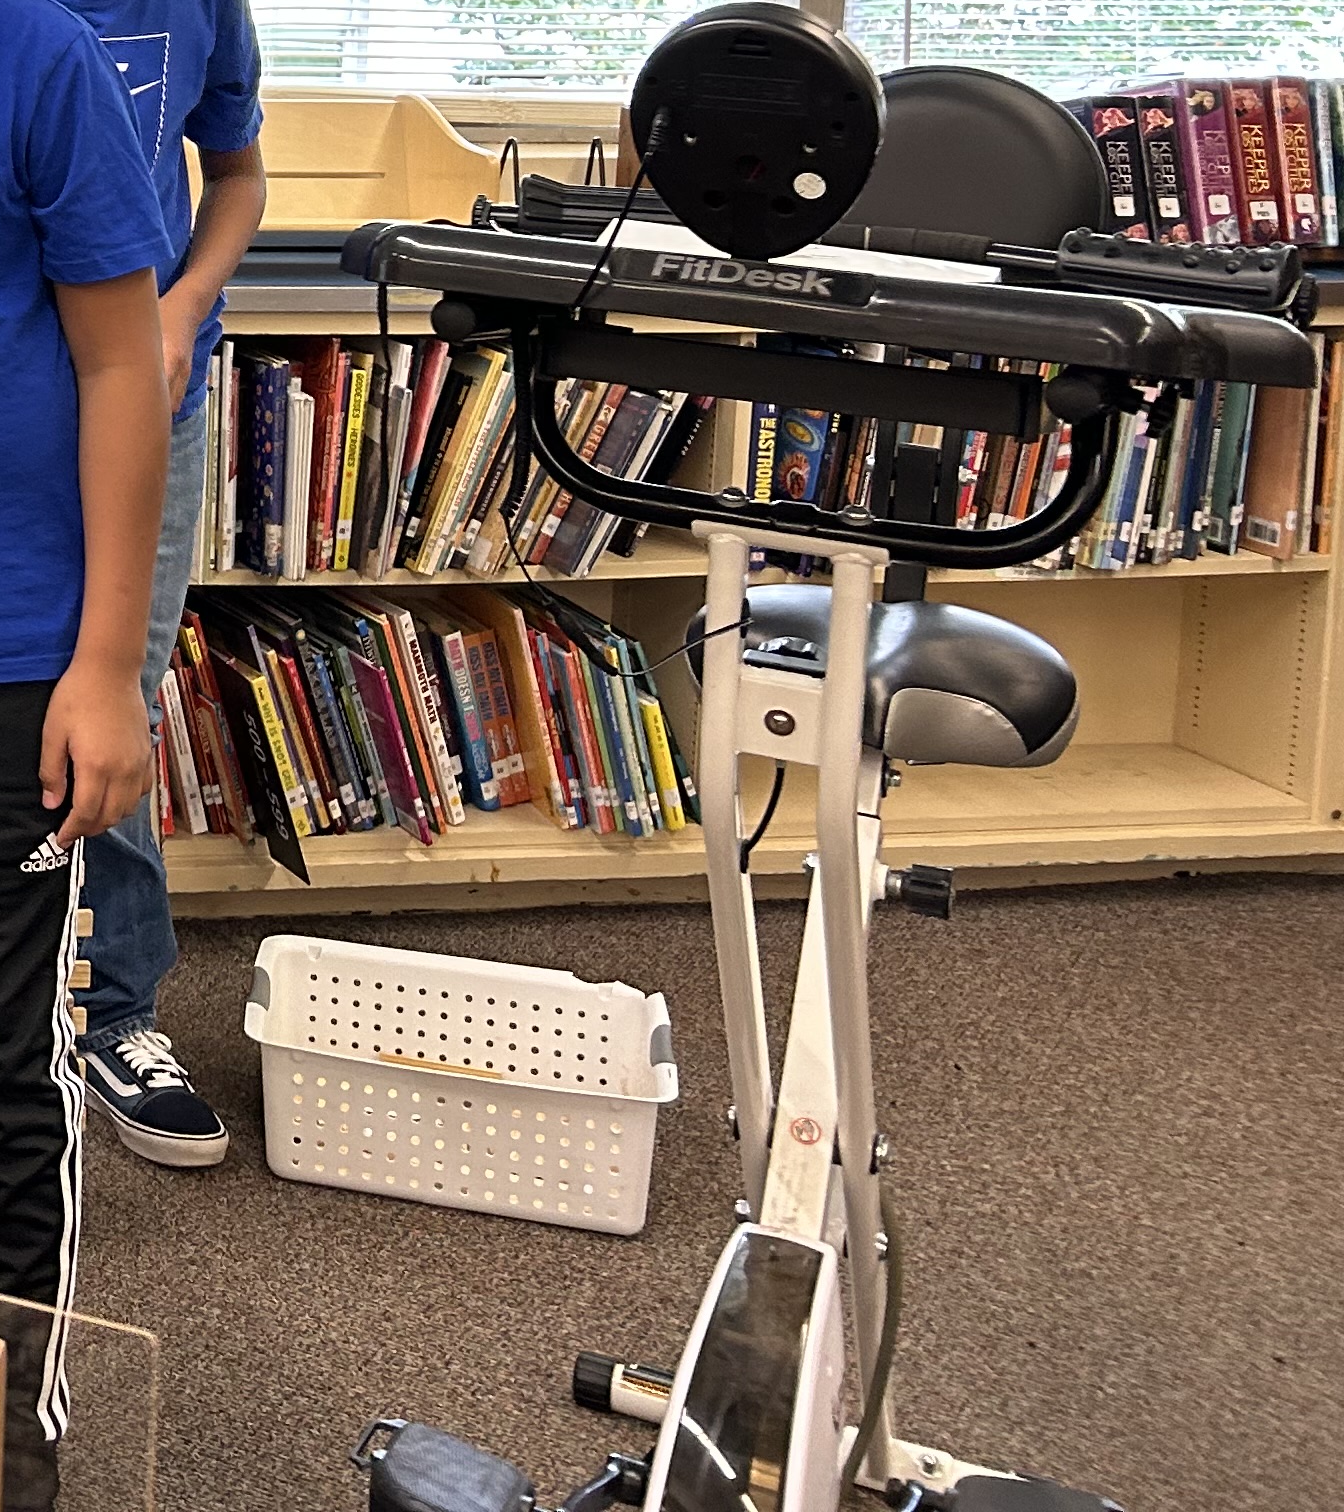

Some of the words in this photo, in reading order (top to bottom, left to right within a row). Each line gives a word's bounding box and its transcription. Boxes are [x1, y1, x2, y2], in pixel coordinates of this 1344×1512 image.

[1116, 142, 1131, 196] KEEPE
[1160, 143, 1177, 198] KEEPE
[1251, 125, 1269, 192] KEEPER
[1294, 124, 1311, 191] KEEPER
[650, 252, 836, 296] FitDesk
[581, 424, 606, 462] GREE
[755, 430, 775, 503] ASTRONO
[408, 640, 430, 693] MAMMOTH
[422, 696, 436, 724] MATH
[243, 711, 267, 762] 500
[265, 791, 290, 842] 599
[20, 852, 69, 873] adidas
